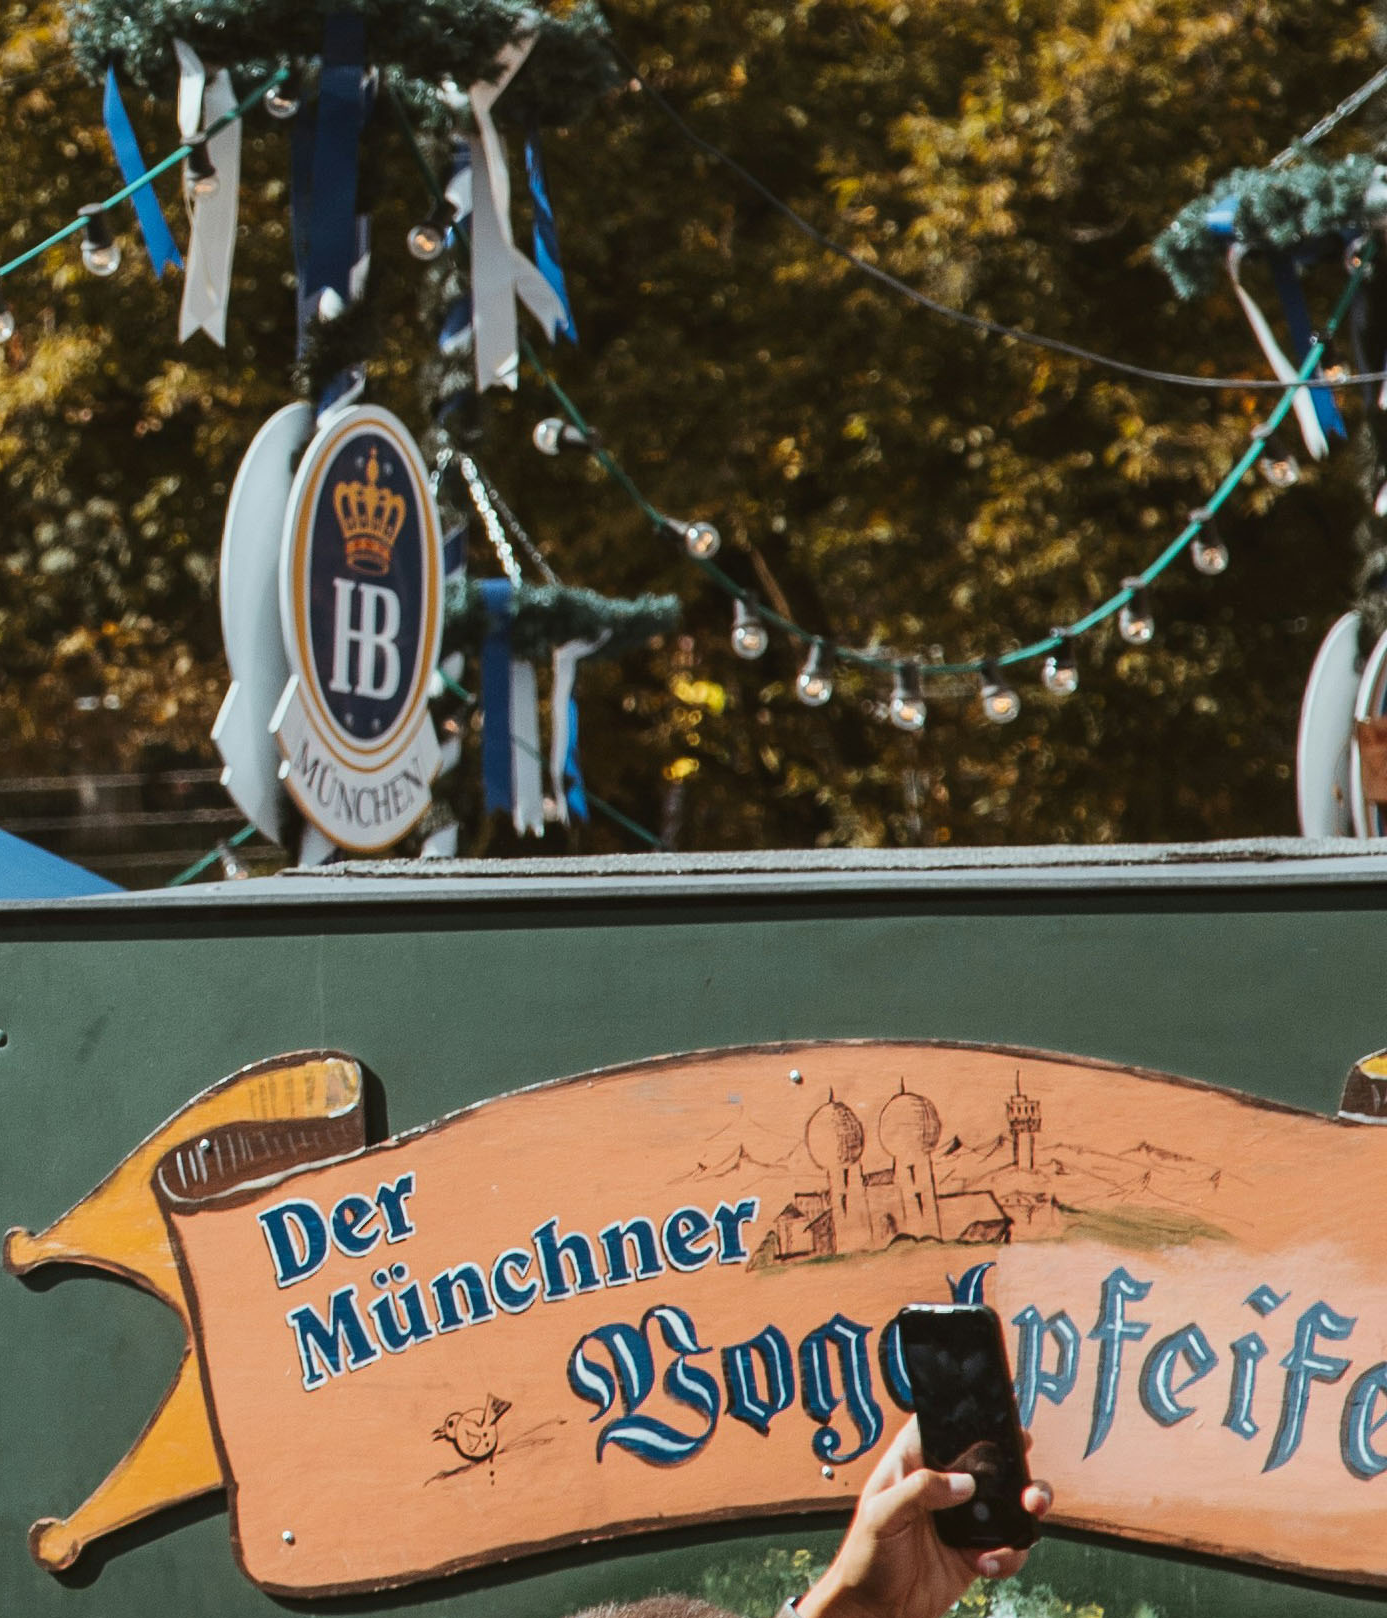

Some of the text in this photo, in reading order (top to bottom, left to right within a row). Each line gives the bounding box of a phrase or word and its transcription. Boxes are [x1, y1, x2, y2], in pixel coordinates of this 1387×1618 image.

[329, 577, 402, 700] HB
[294, 740, 424, 828] MÜNCHEN
[257, 1172, 416, 1289] Der
[286, 1198, 760, 1392] Münchner
[567, 1261, 1387, 1482] Vogpfeife
